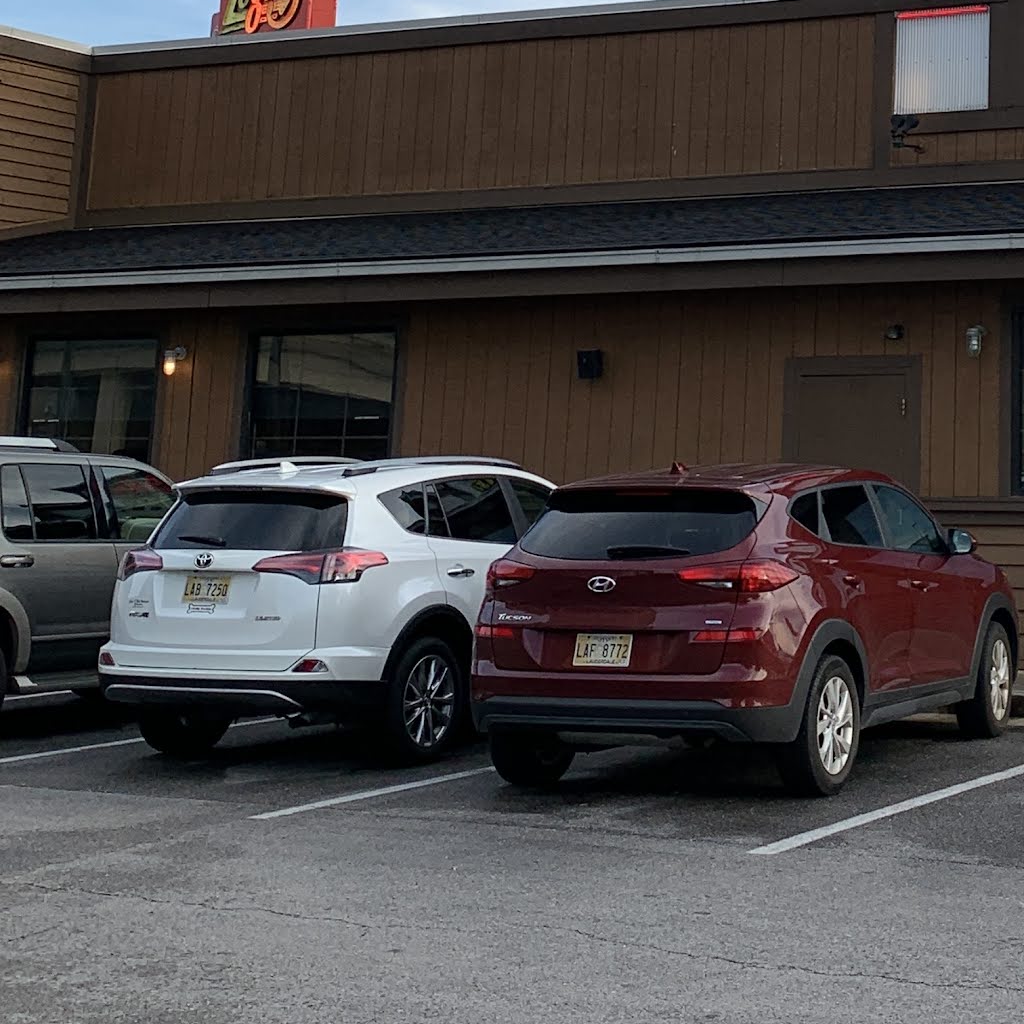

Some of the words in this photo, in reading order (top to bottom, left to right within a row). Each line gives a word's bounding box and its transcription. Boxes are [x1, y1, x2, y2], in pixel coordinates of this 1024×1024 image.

[184, 583, 201, 596] LAB
[576, 643, 597, 658] LAF
[602, 643, 629, 659] 8772
